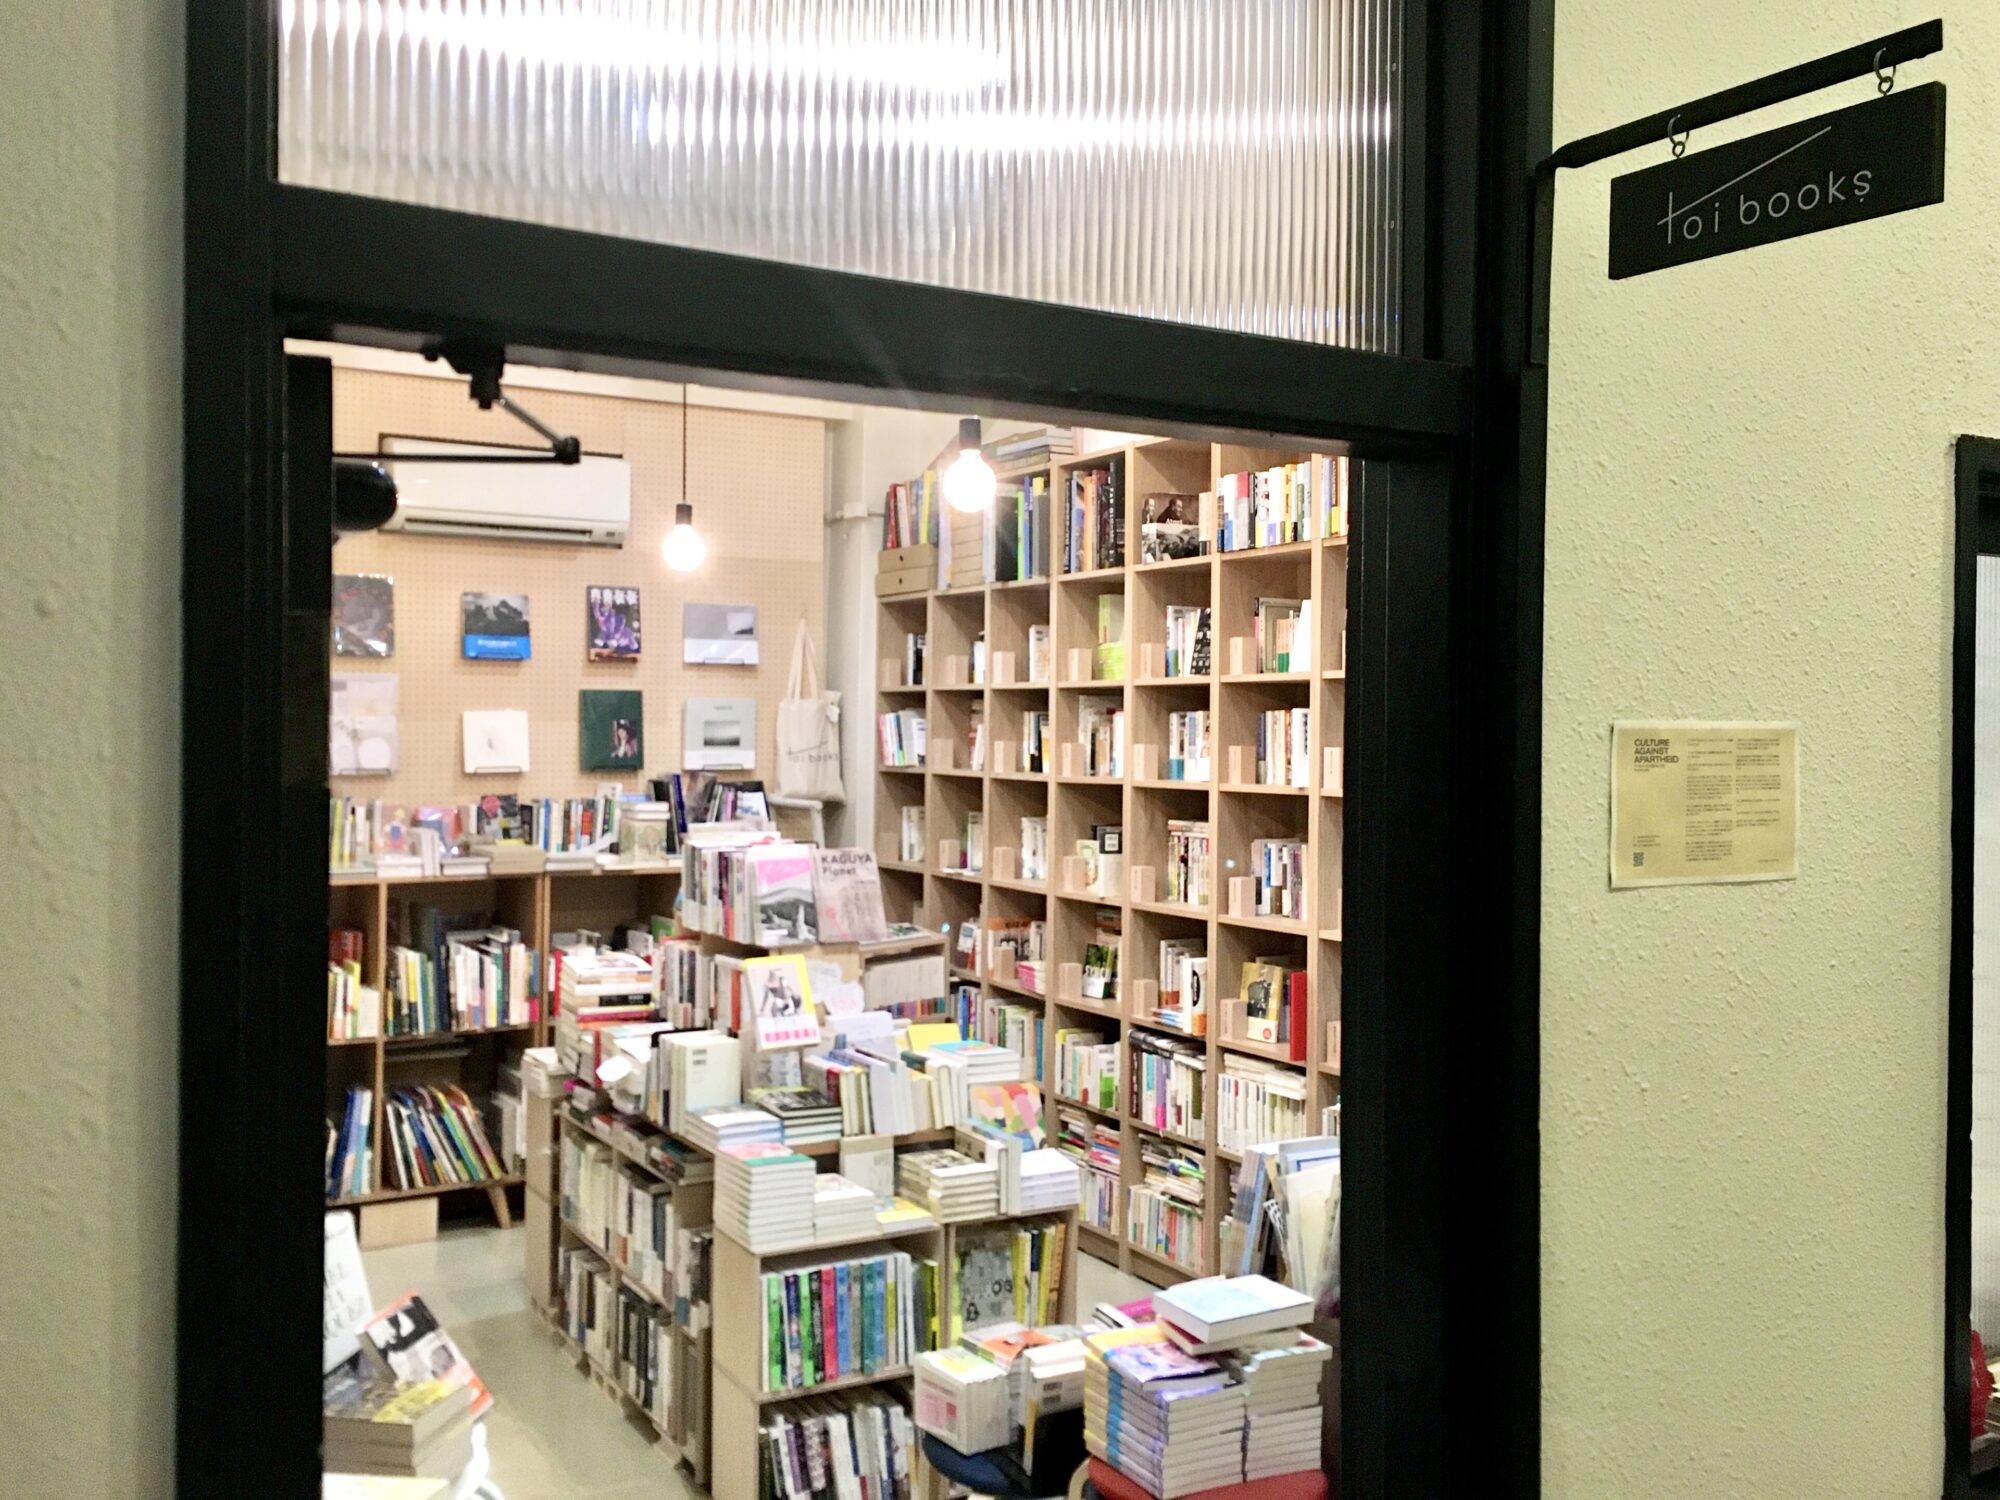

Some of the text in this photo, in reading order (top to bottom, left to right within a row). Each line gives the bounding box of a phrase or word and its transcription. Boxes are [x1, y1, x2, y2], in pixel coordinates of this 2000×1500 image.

[1738, 169, 1873, 226] books
[1634, 738, 1670, 747] CULTURE
[1634, 747, 1669, 755] AGAINST
[1634, 755, 1679, 763] APARTHEID
[821, 853, 873, 865] KAGUYA
